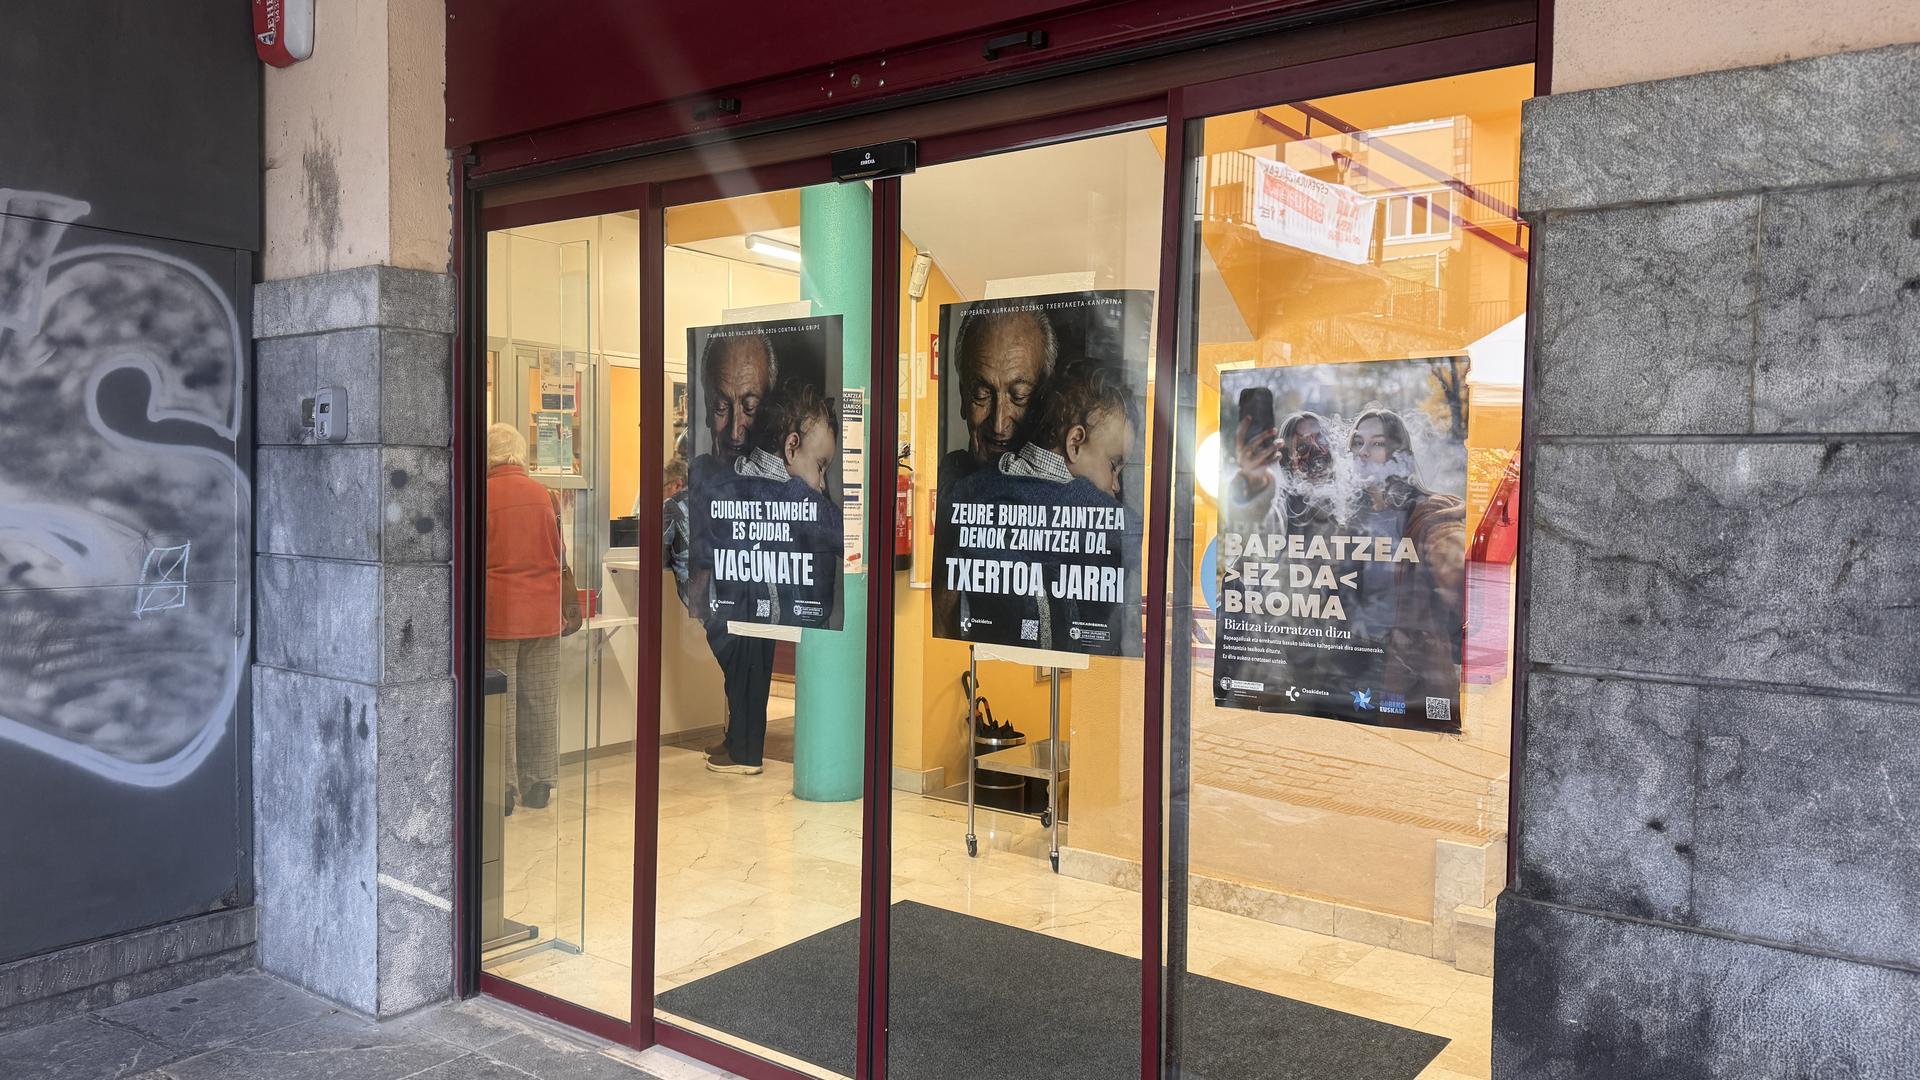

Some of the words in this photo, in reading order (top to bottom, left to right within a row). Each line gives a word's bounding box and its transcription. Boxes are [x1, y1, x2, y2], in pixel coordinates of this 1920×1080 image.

[992, 306, 1020, 314] AURKAKO
[778, 325, 797, 333] CONTRA
[806, 323, 820, 331] GRIPE
[710, 500, 763, 520] CUIDARTE
[764, 497, 818, 522] TAMBIÉN
[951, 503, 994, 525] ZEURE
[998, 504, 1047, 527] BURUA
[1051, 506, 1125, 530] ZAINTZEA
[732, 521, 746, 540] ES
[748, 522, 794, 542] CUIDAR.
[959, 526, 1006, 549] DENOK
[1010, 529, 1080, 554] ZAINTZEA
[1085, 531, 1111, 555] DA.
[1224, 533, 1420, 563] BAPEATZEA
[713, 542, 814, 586] VACÚNATE
[945, 557, 1044, 597] TXERTOA
[1051, 564, 1124, 604] JARRI
[1224, 589, 1347, 620] BROMA
[971, 617, 993, 625] Osakidetza
[1223, 618, 1262, 633] Bizitza
[1263, 621, 1323, 637] izorratzen
[1325, 626, 1352, 639] dizu
[1301, 687, 1330, 696] Osakidetza
[1379, 706, 1406, 715] EUSKADI
